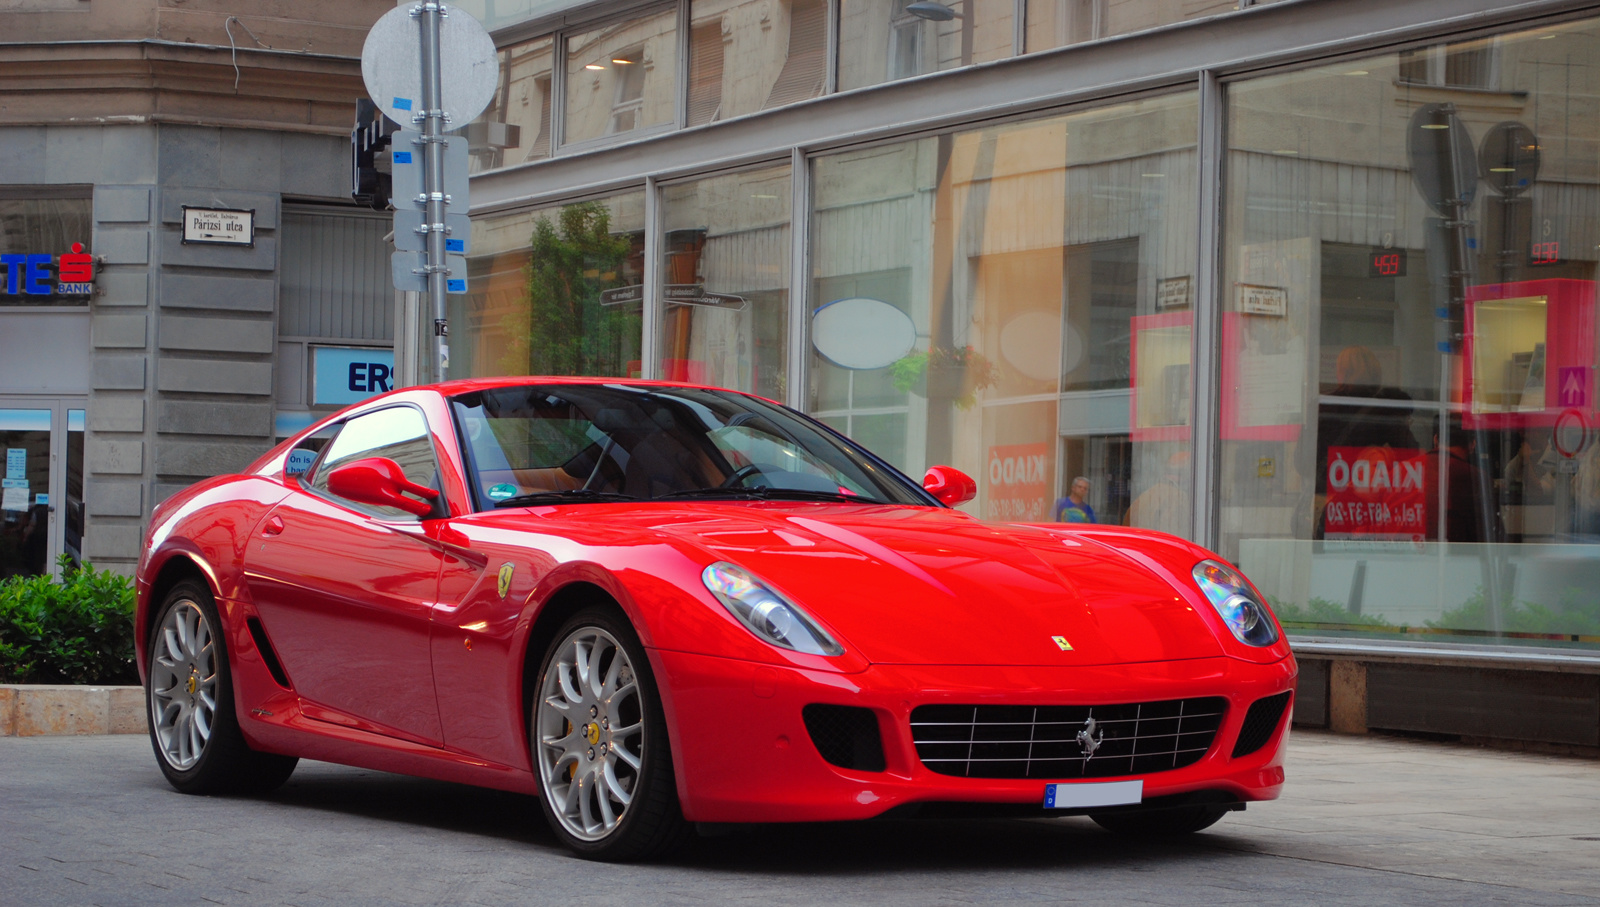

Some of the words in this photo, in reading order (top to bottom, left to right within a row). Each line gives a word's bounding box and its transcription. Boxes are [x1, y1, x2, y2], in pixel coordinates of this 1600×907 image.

[193, 217, 221, 231] Párizsi
[226, 220, 243, 232] utca
[1543, 218, 1551, 237] 3
[1384, 232, 1392, 250] 2
[1532, 242, 1559, 264] 938
[1374, 254, 1399, 275] 459
[58, 284, 91, 293] BANK
[349, 362, 394, 392] ER
